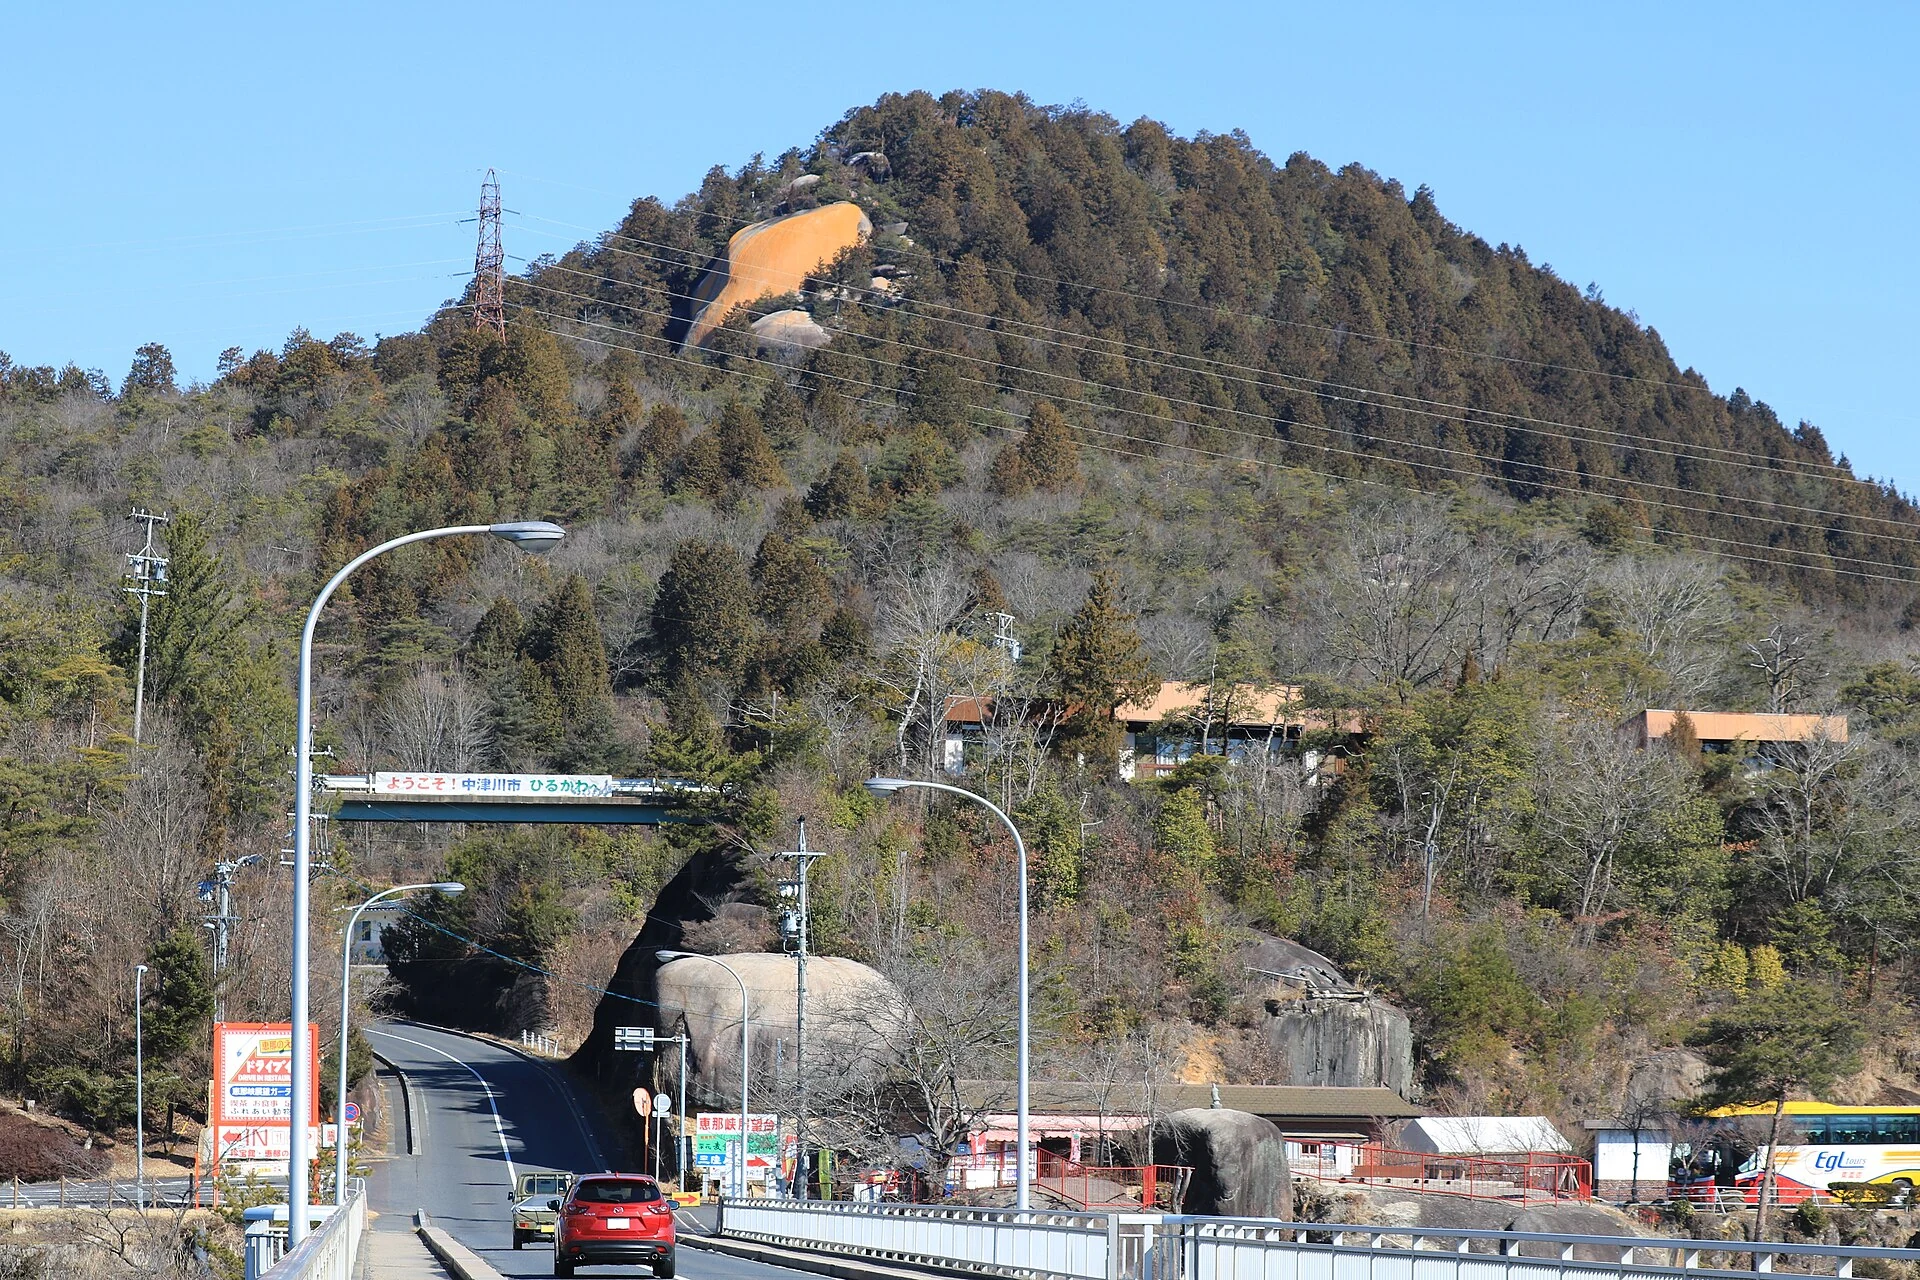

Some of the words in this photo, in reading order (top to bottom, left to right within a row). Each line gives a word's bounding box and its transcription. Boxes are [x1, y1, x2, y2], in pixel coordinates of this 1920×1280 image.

[386, 776, 457, 791] ようこそ！
[461, 777, 522, 792] 中津川市
[245, 1128, 268, 1147] IN
[1845, 1157, 1867, 1165] tours
